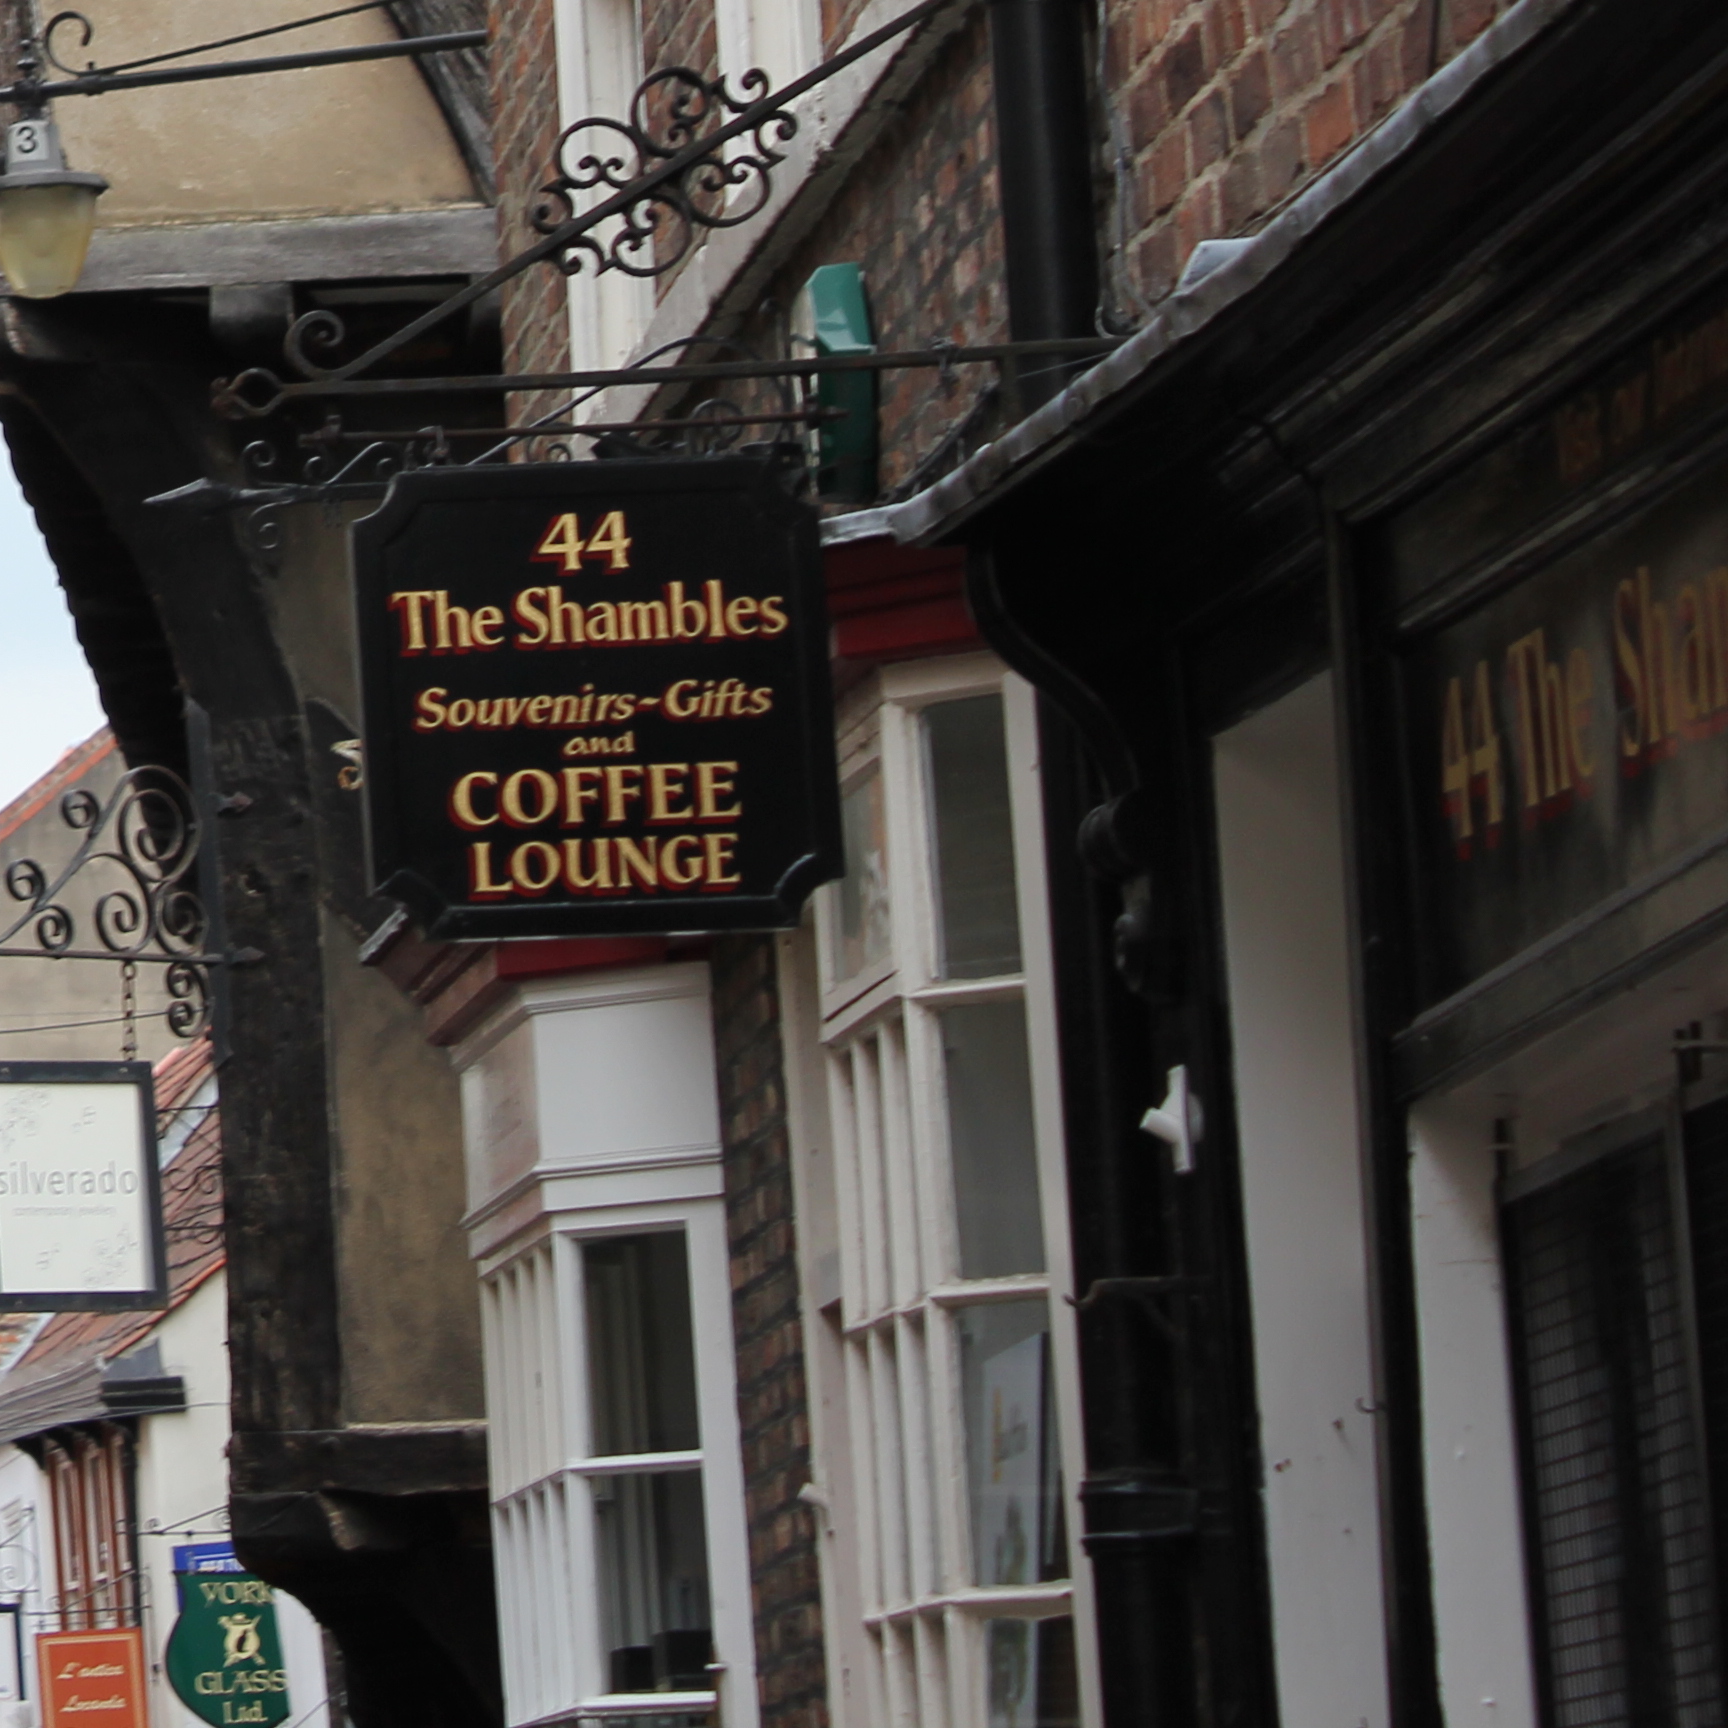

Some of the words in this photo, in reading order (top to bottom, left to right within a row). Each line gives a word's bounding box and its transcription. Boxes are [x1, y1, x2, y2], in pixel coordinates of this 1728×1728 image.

[533, 509, 633, 574] 44
[389, 589, 505, 653] The
[513, 578, 790, 647] Shambles
[562, 731, 635, 756] and
[1442, 658, 1503, 840] 44
[1507, 627, 1596, 808] The
[451, 760, 743, 828] COFFEE
[470, 832, 743, 895] LOUNGE
[194, 1668, 290, 1696] GLASS
